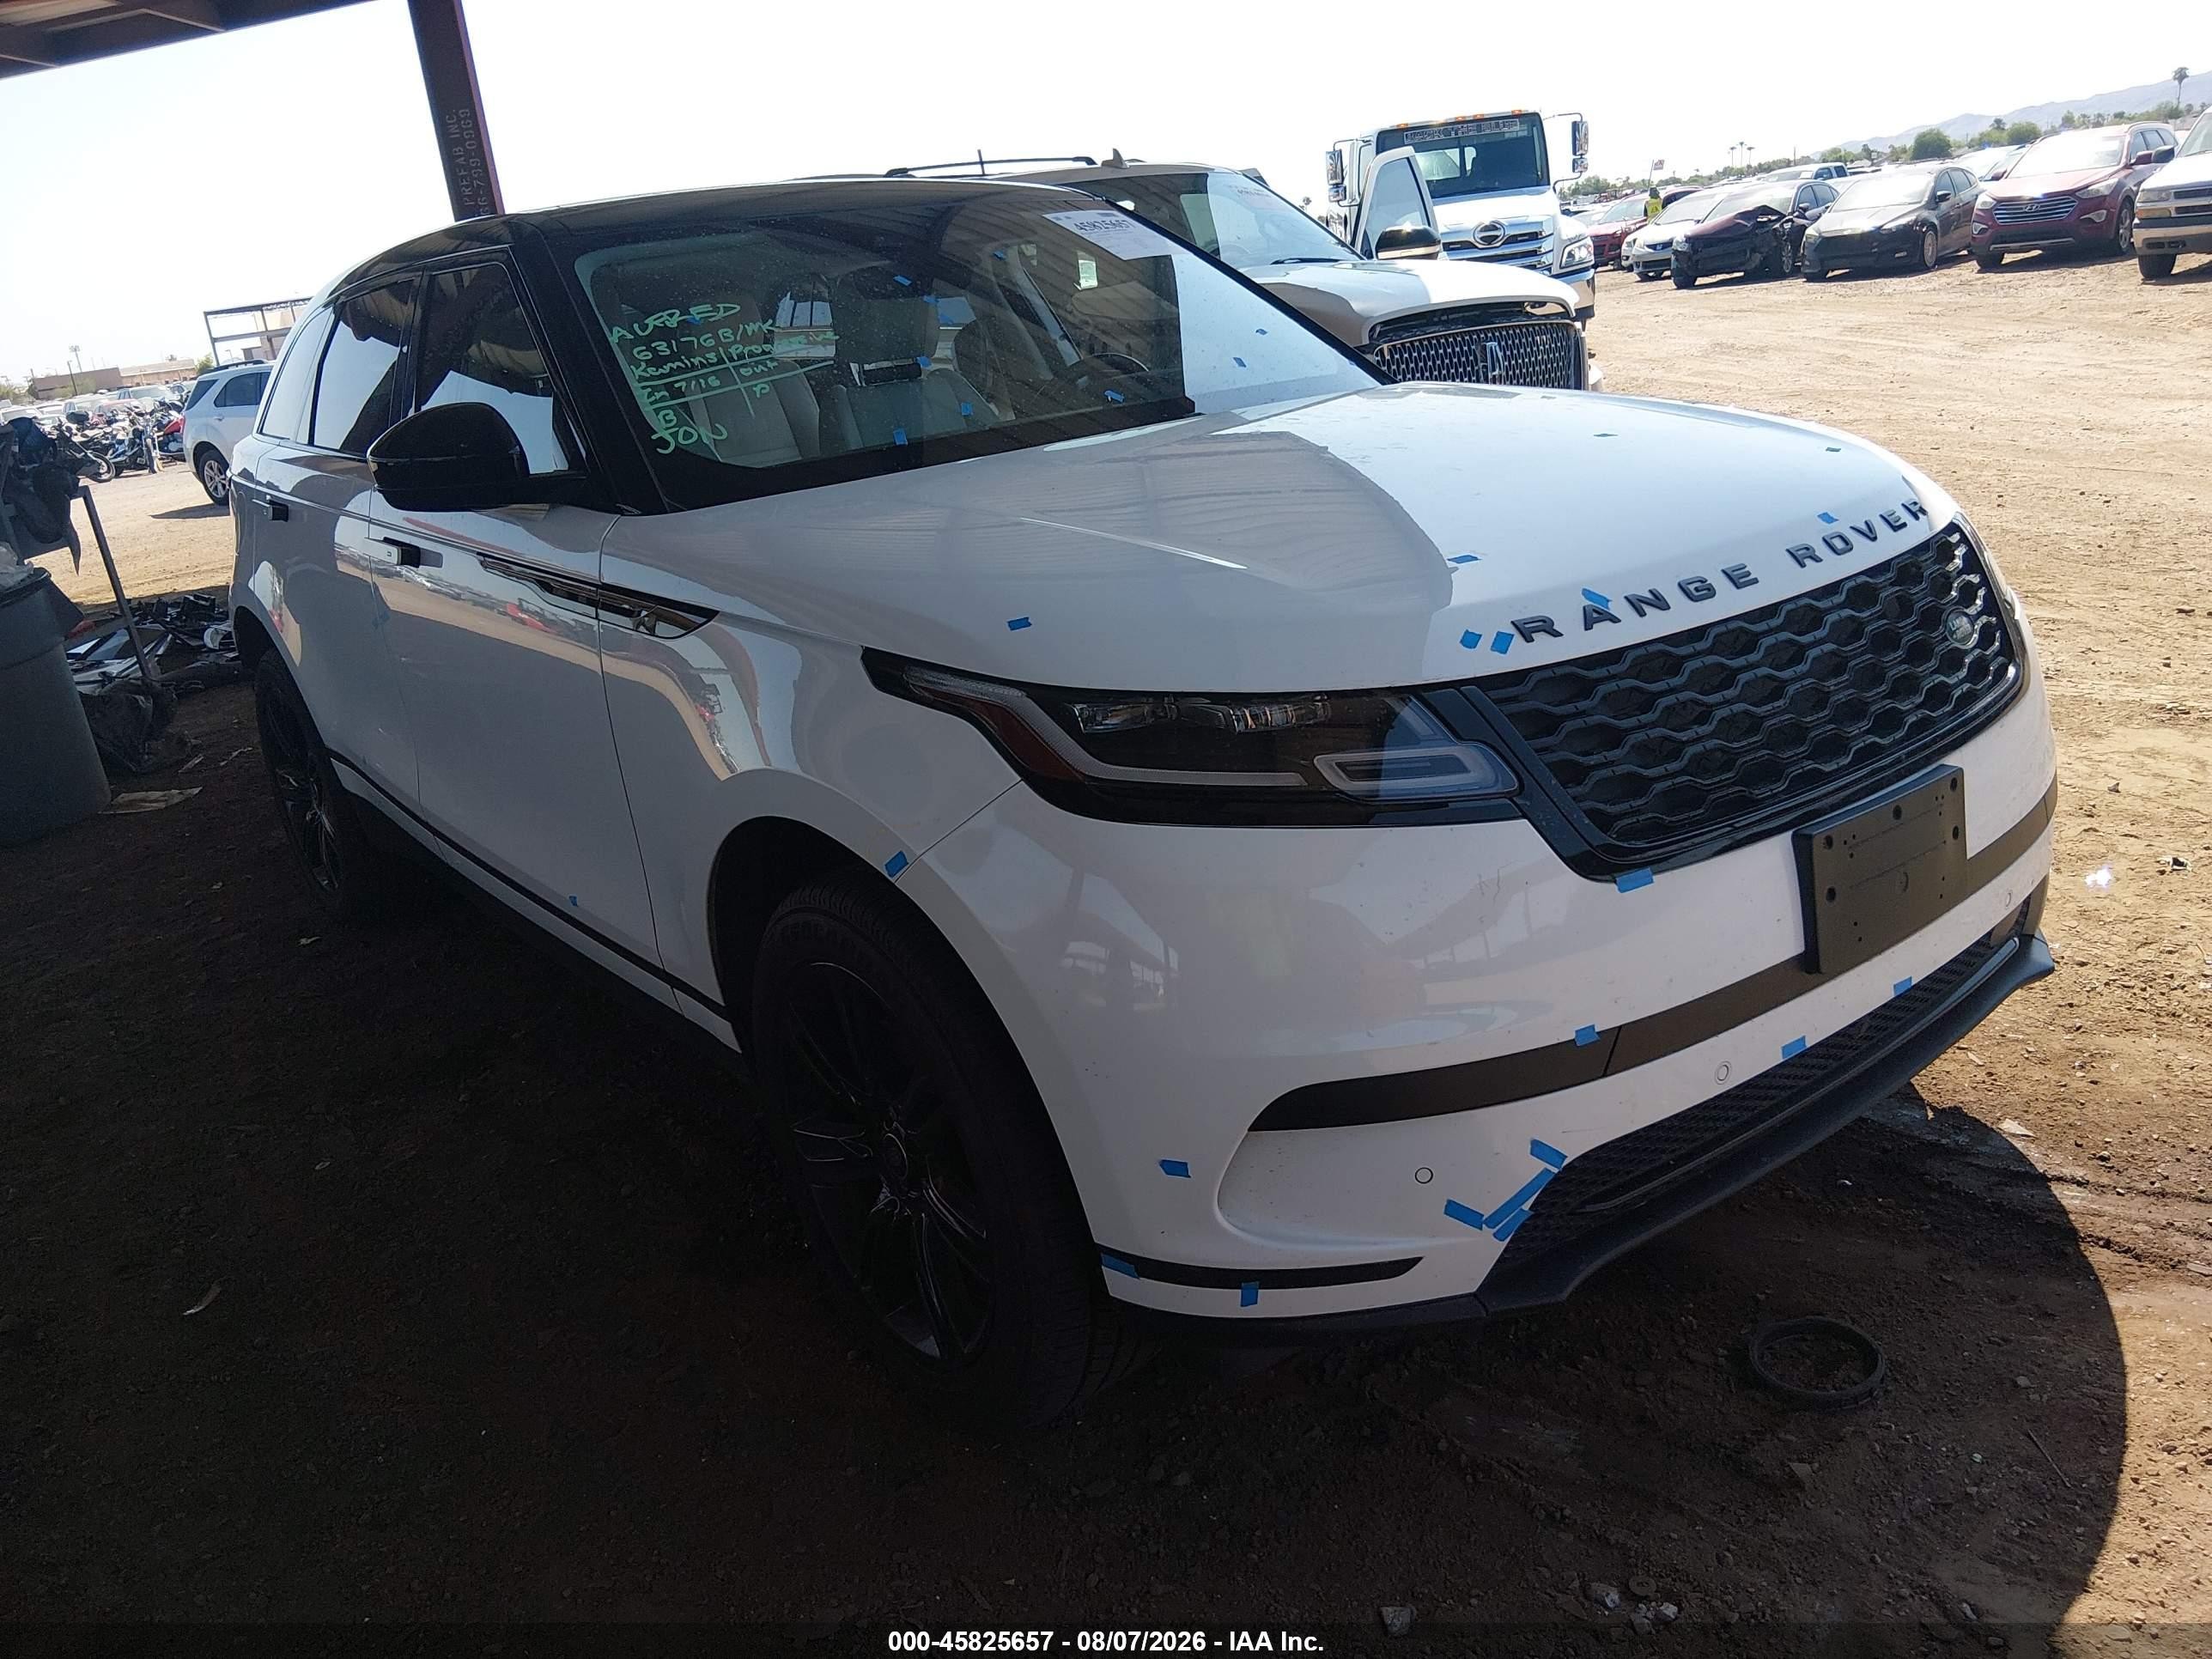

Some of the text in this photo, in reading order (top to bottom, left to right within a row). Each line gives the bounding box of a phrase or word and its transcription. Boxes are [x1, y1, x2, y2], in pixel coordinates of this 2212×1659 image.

[446, 109, 476, 206] PREFAB INC.
[1511, 498, 1929, 644] RANGE ROVER
